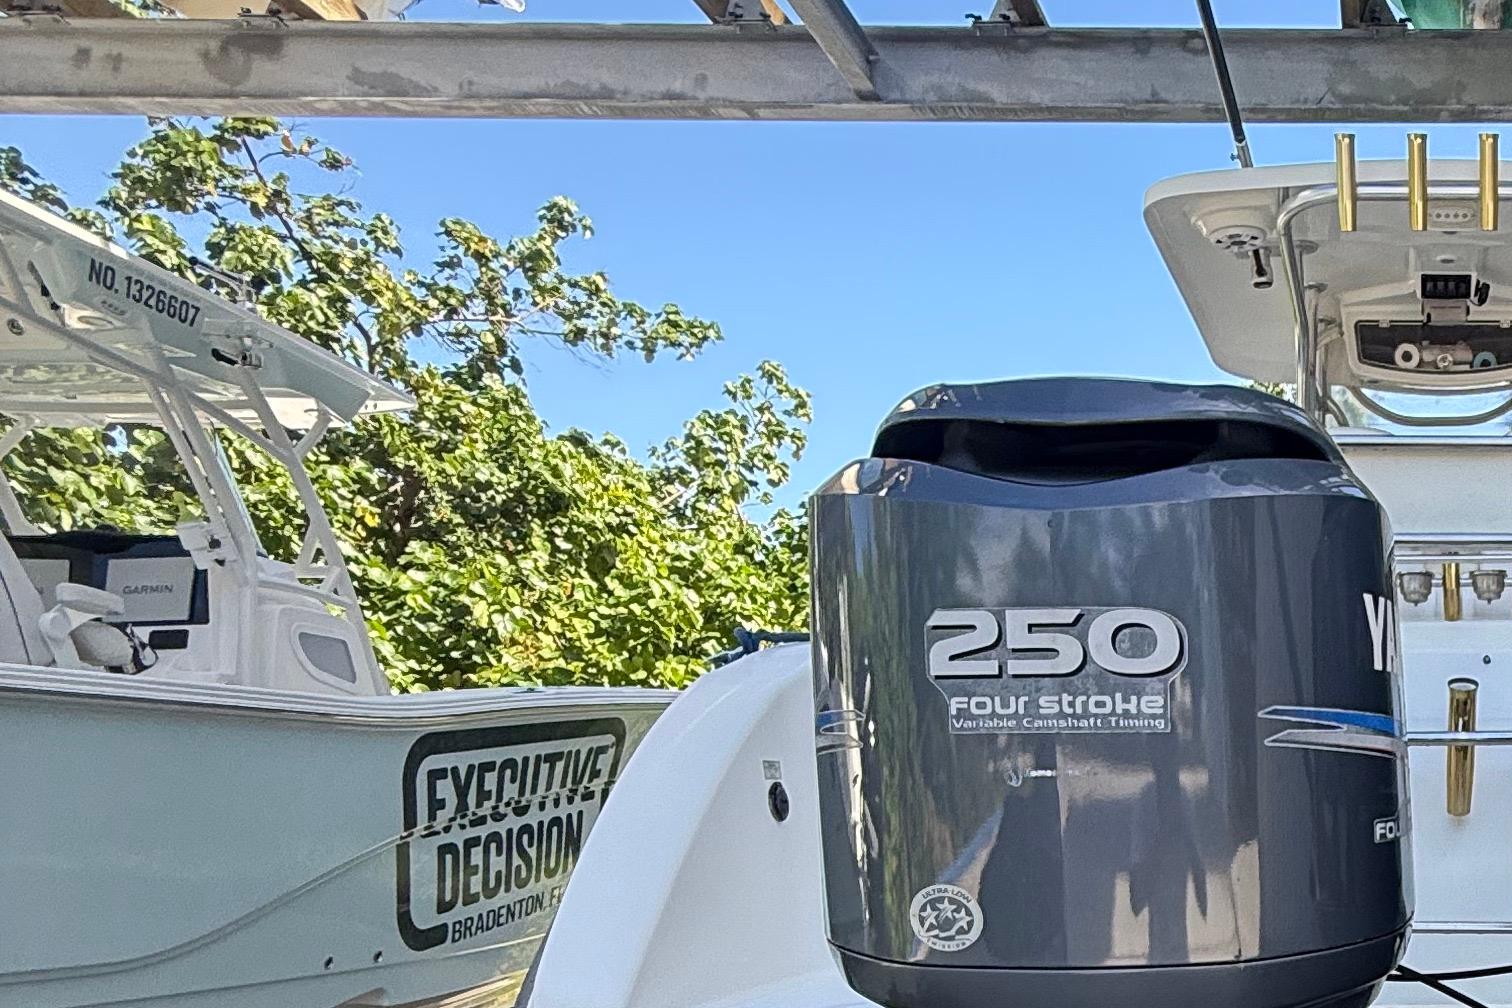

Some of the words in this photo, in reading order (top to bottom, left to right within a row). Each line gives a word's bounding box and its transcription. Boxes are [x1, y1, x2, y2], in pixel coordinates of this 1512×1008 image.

[88, 258, 119, 294] NO.
[124, 275, 201, 328] 1326607
[122, 585, 174, 596] GARMIN
[924, 608, 1187, 679] 250
[951, 717, 1017, 729] Variable
[1022, 717, 1102, 728] Camshaft
[1108, 716, 1166, 730] Timing
[420, 744, 612, 839] EXECUTIVE
[436, 809, 584, 915] DECISION
